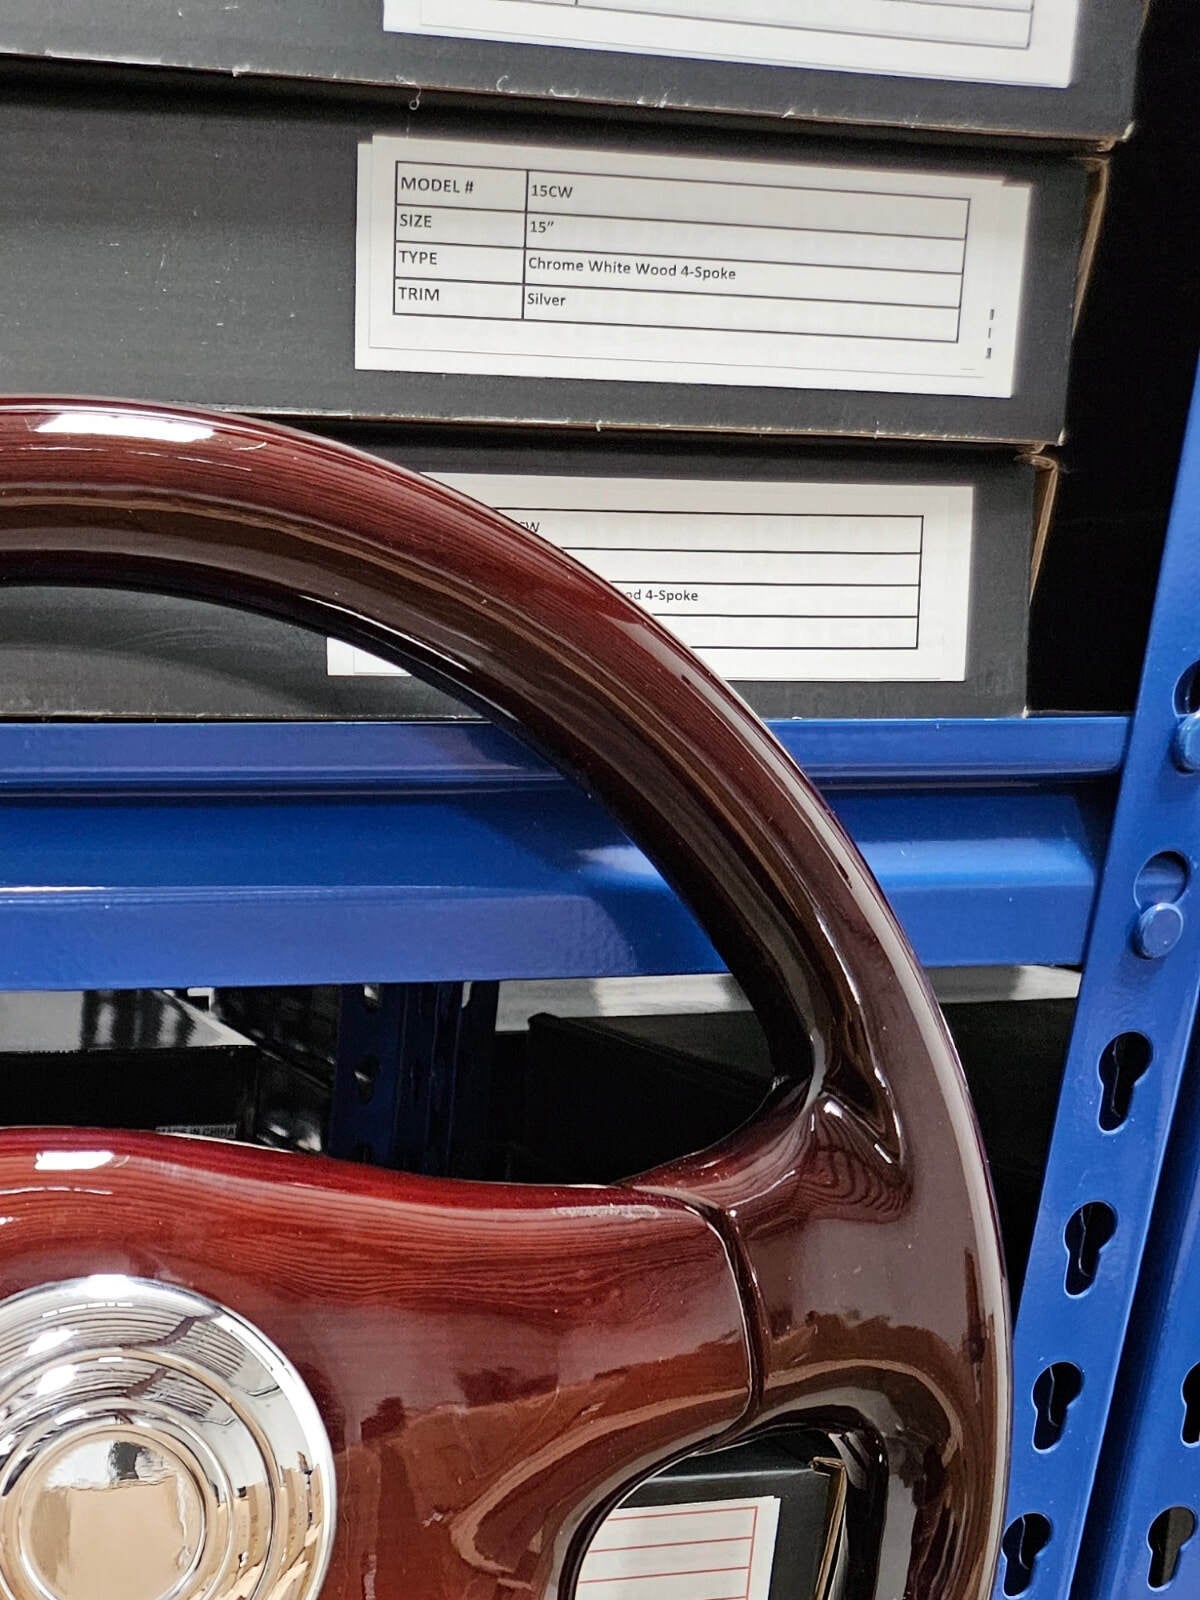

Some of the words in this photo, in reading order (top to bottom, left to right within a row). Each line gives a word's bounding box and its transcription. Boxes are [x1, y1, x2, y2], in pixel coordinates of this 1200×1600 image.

[401, 176, 460, 194] MODEL
[465, 180, 474, 194] #
[531, 184, 573, 199] 15CW
[400, 213, 432, 229] SIZE
[530, 221, 554, 233] 15"
[399, 250, 438, 265] TYPE
[528, 257, 584, 272] Chrome
[588, 260, 631, 275] White
[636, 262, 676, 277] Wood
[680, 265, 737, 281] 4-Spoke
[398, 287, 440, 302] TRIM
[527, 292, 566, 307] Silver
[645, 589, 699, 603] 4-Spoke
